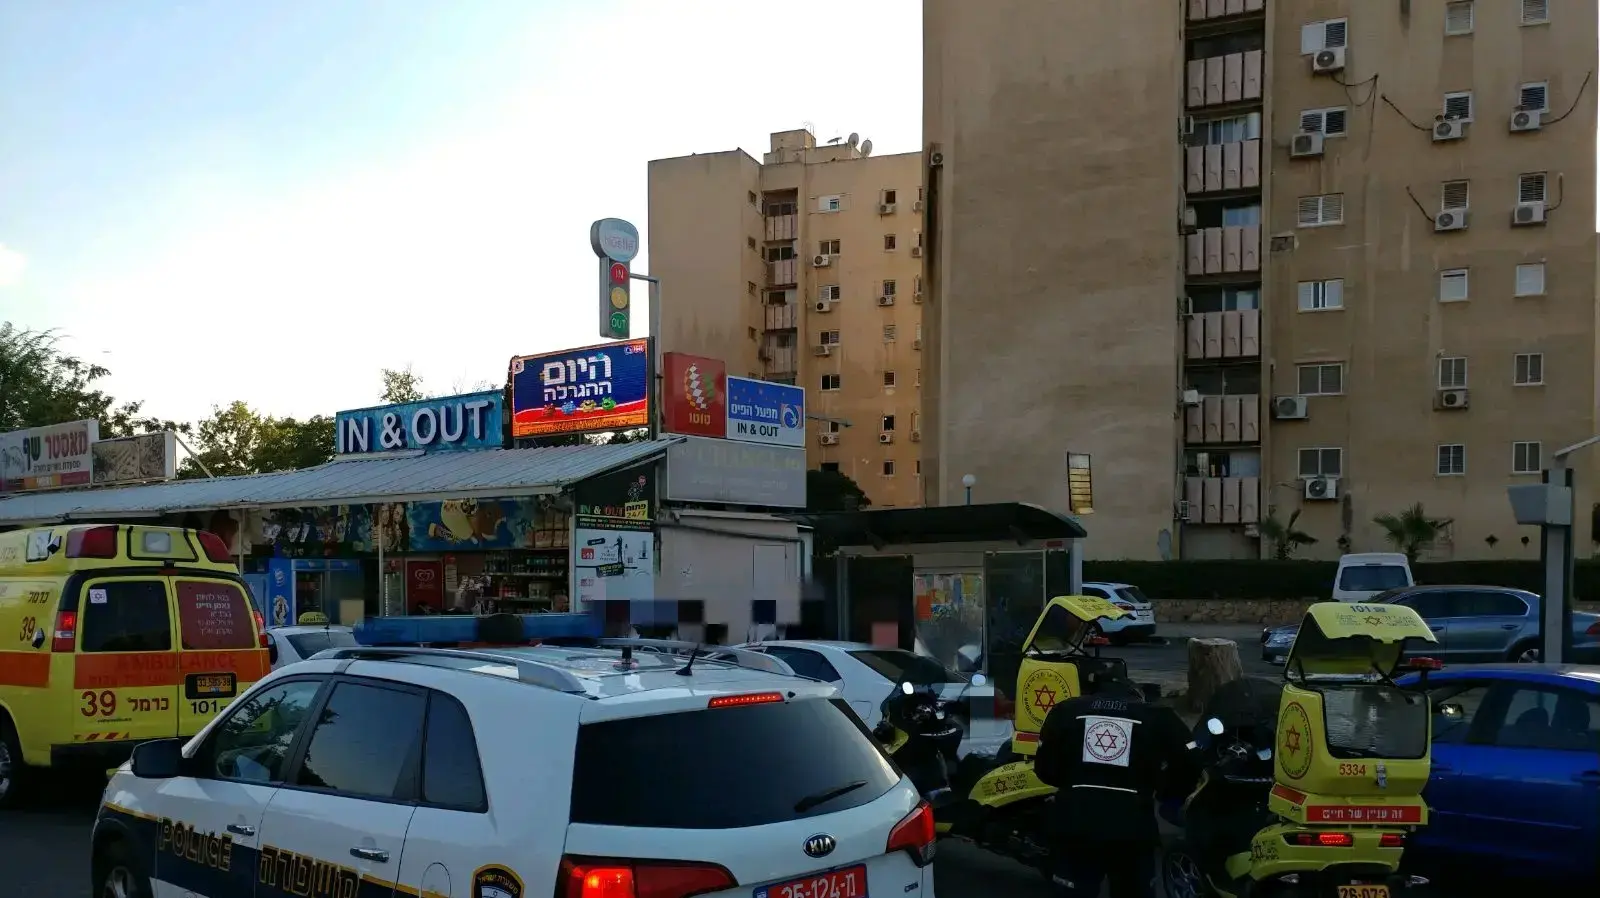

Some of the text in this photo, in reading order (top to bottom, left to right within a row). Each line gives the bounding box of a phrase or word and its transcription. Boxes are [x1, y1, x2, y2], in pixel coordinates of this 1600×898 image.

[615, 268, 624, 279] IN
[611, 317, 627, 329] OUT
[543, 354, 612, 386] היום
[543, 381, 612, 402] ההגרלה
[689, 412, 711, 426] טוטו
[730, 403, 778, 420] מפעל הפיס
[338, 416, 369, 453] IN
[379, 412, 403, 449] &
[411, 400, 489, 445] OUT
[737, 422, 780, 437] IN & OUT
[22, 430, 88, 471] מאסטר שף
[581, 504, 626, 517] IN & OUT
[626, 503, 647, 512] פתוח
[626, 511, 646, 519] 24/7
[19, 615, 36, 641] 39
[117, 652, 237, 671] AMBULANCE
[80, 690, 117, 717] 39
[128, 697, 170, 712] כרמל
[190, 701, 218, 714] 101
[1339, 763, 1366, 776] 5334
[1322, 808, 1403, 820] זה עניין של חיים
[157, 816, 233, 872] POLICE
[809, 837, 833, 853] KIA
[259, 844, 360, 898] משטרה
